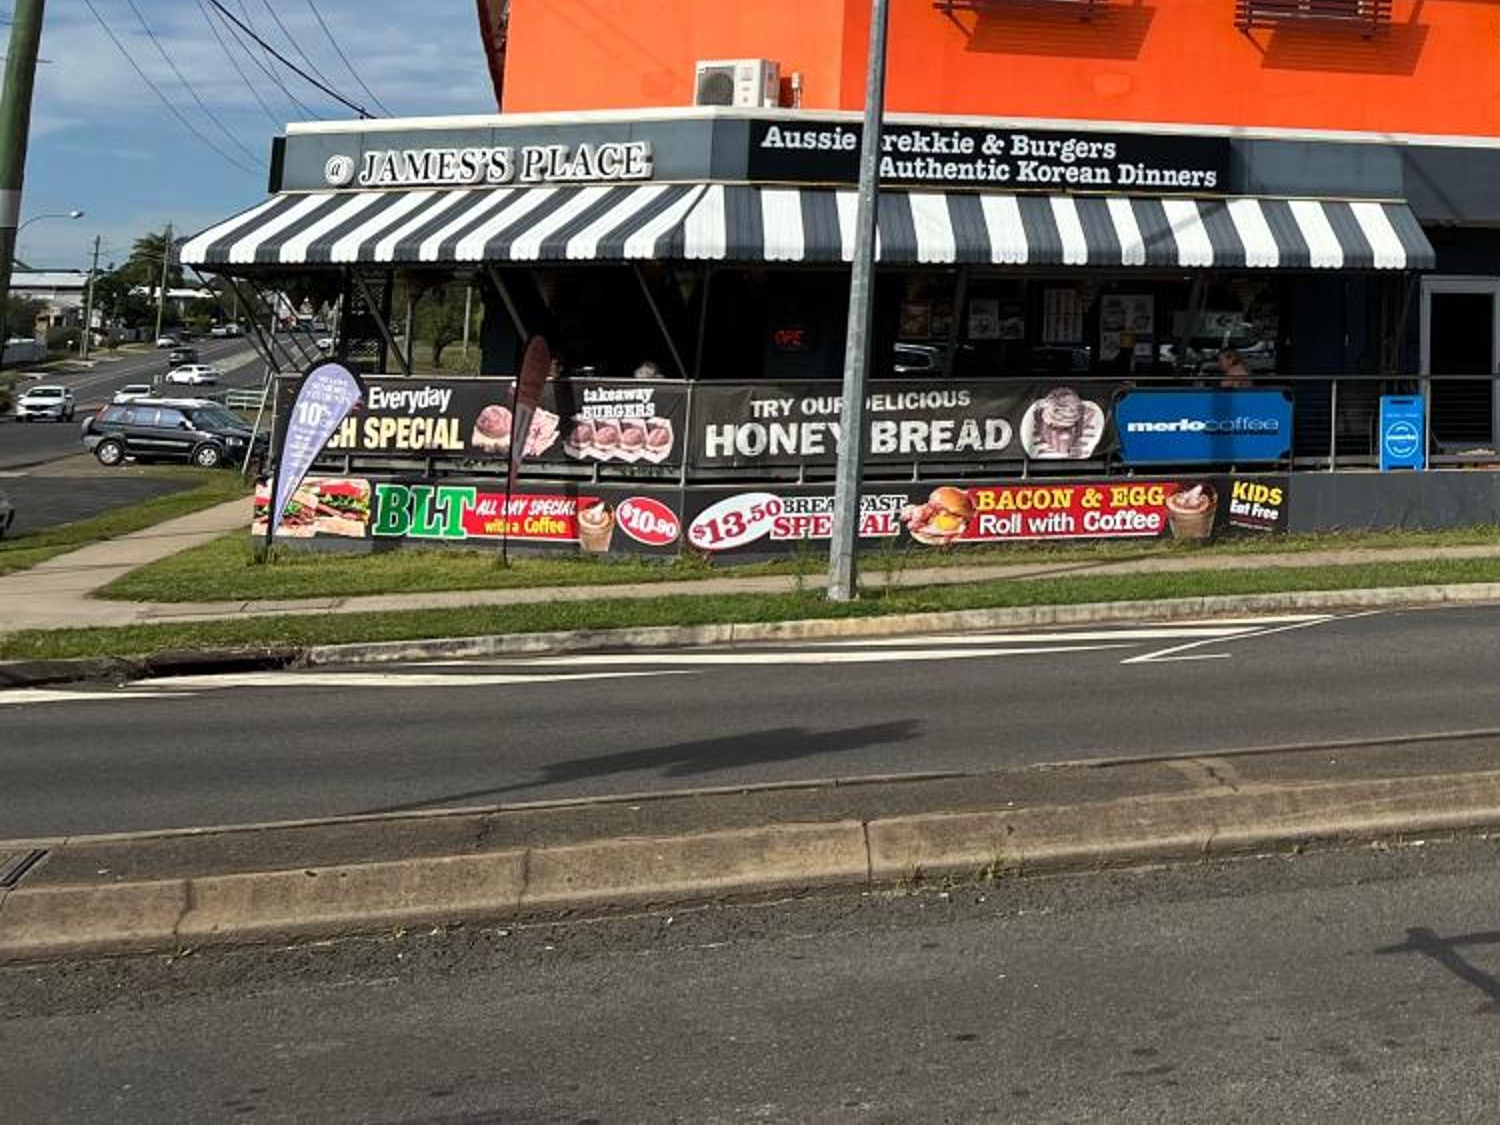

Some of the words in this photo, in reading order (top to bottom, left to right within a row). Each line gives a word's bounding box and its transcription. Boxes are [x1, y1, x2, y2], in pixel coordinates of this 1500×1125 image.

[760, 126, 857, 150] Aussie
[881, 130, 975, 154] rekkie
[981, 133, 1006, 156] &
[1010, 135, 1117, 162] Burgers
[325, 155, 352, 184] @
[360, 147, 508, 183] JAMES'S
[522, 143, 648, 181] PLACE
[880, 155, 1010, 181] Authentic
[1016, 160, 1110, 184] Korean
[1117, 163, 1217, 187] Dinners
[368, 386, 452, 412] Everyday
[583, 386, 655, 403] takeaway
[582, 402, 656, 419] BURGERS
[751, 398, 795, 418] TRY
[363, 416, 465, 450] SPECIAL
[870, 418, 1013, 454] BREAD
[783, 496, 906, 514] BREAAST
[976, 489, 1072, 510] BACON
[1081, 488, 1103, 508] &
[1110, 486, 1165, 507] EGG
[1232, 480, 1283, 506] KIDS
[372, 483, 478, 538] BLT
[476, 498, 498, 516] ALL
[528, 499, 577, 516] SPECIAL
[1230, 498, 1251, 516] Eat
[1251, 503, 1279, 520] Free
[524, 517, 566, 534] Coffee
[692, 500, 782, 544] $13.50
[772, 513, 899, 538] SPEAL
[979, 513, 1021, 535] Roll
[1028, 512, 1078, 533] with
[1083, 509, 1161, 531] Coffee
